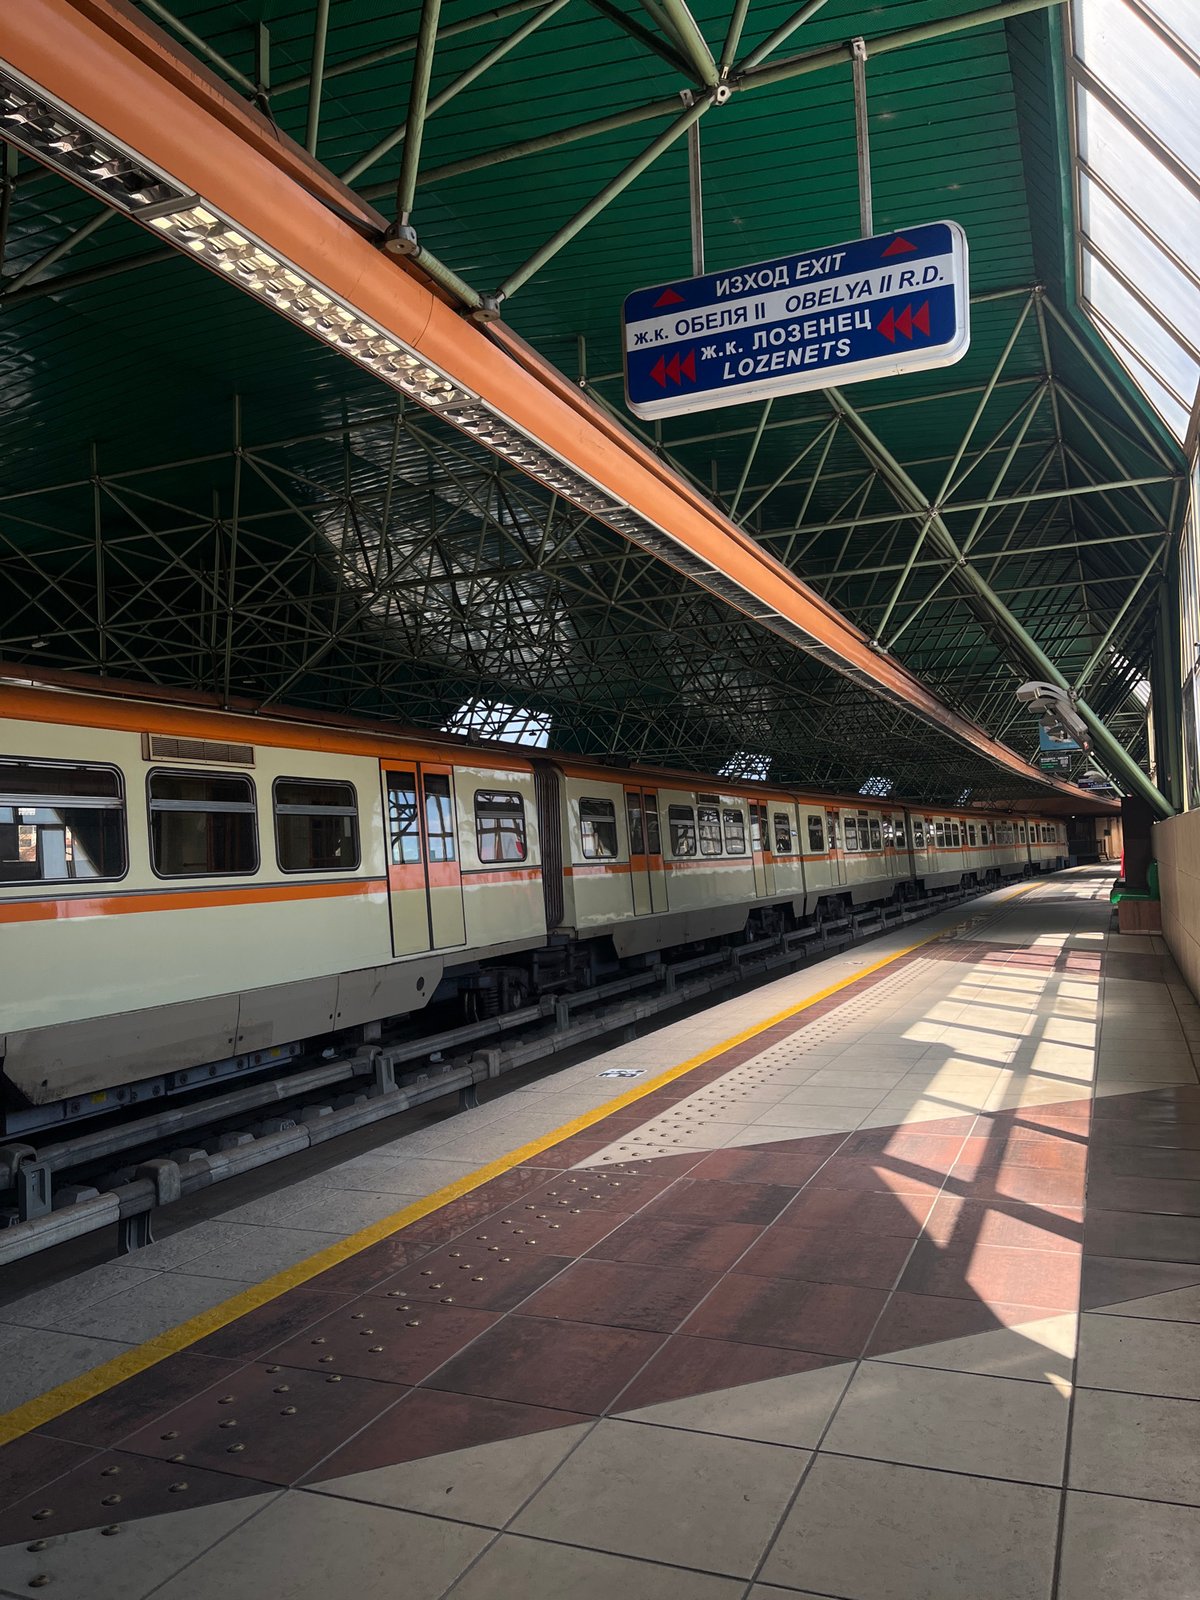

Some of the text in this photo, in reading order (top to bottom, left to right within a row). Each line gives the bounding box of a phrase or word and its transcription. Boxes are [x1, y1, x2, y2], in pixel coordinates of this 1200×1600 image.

[716, 252, 846, 297] ИЗХОД EXIT
[634, 265, 944, 345] ж.к. ОБЕЛЯ II OBELYA II R.D.
[701, 309, 872, 360] ж.к. ЛОЗЕНЕЦ
[723, 338, 851, 380] LOZENETS
